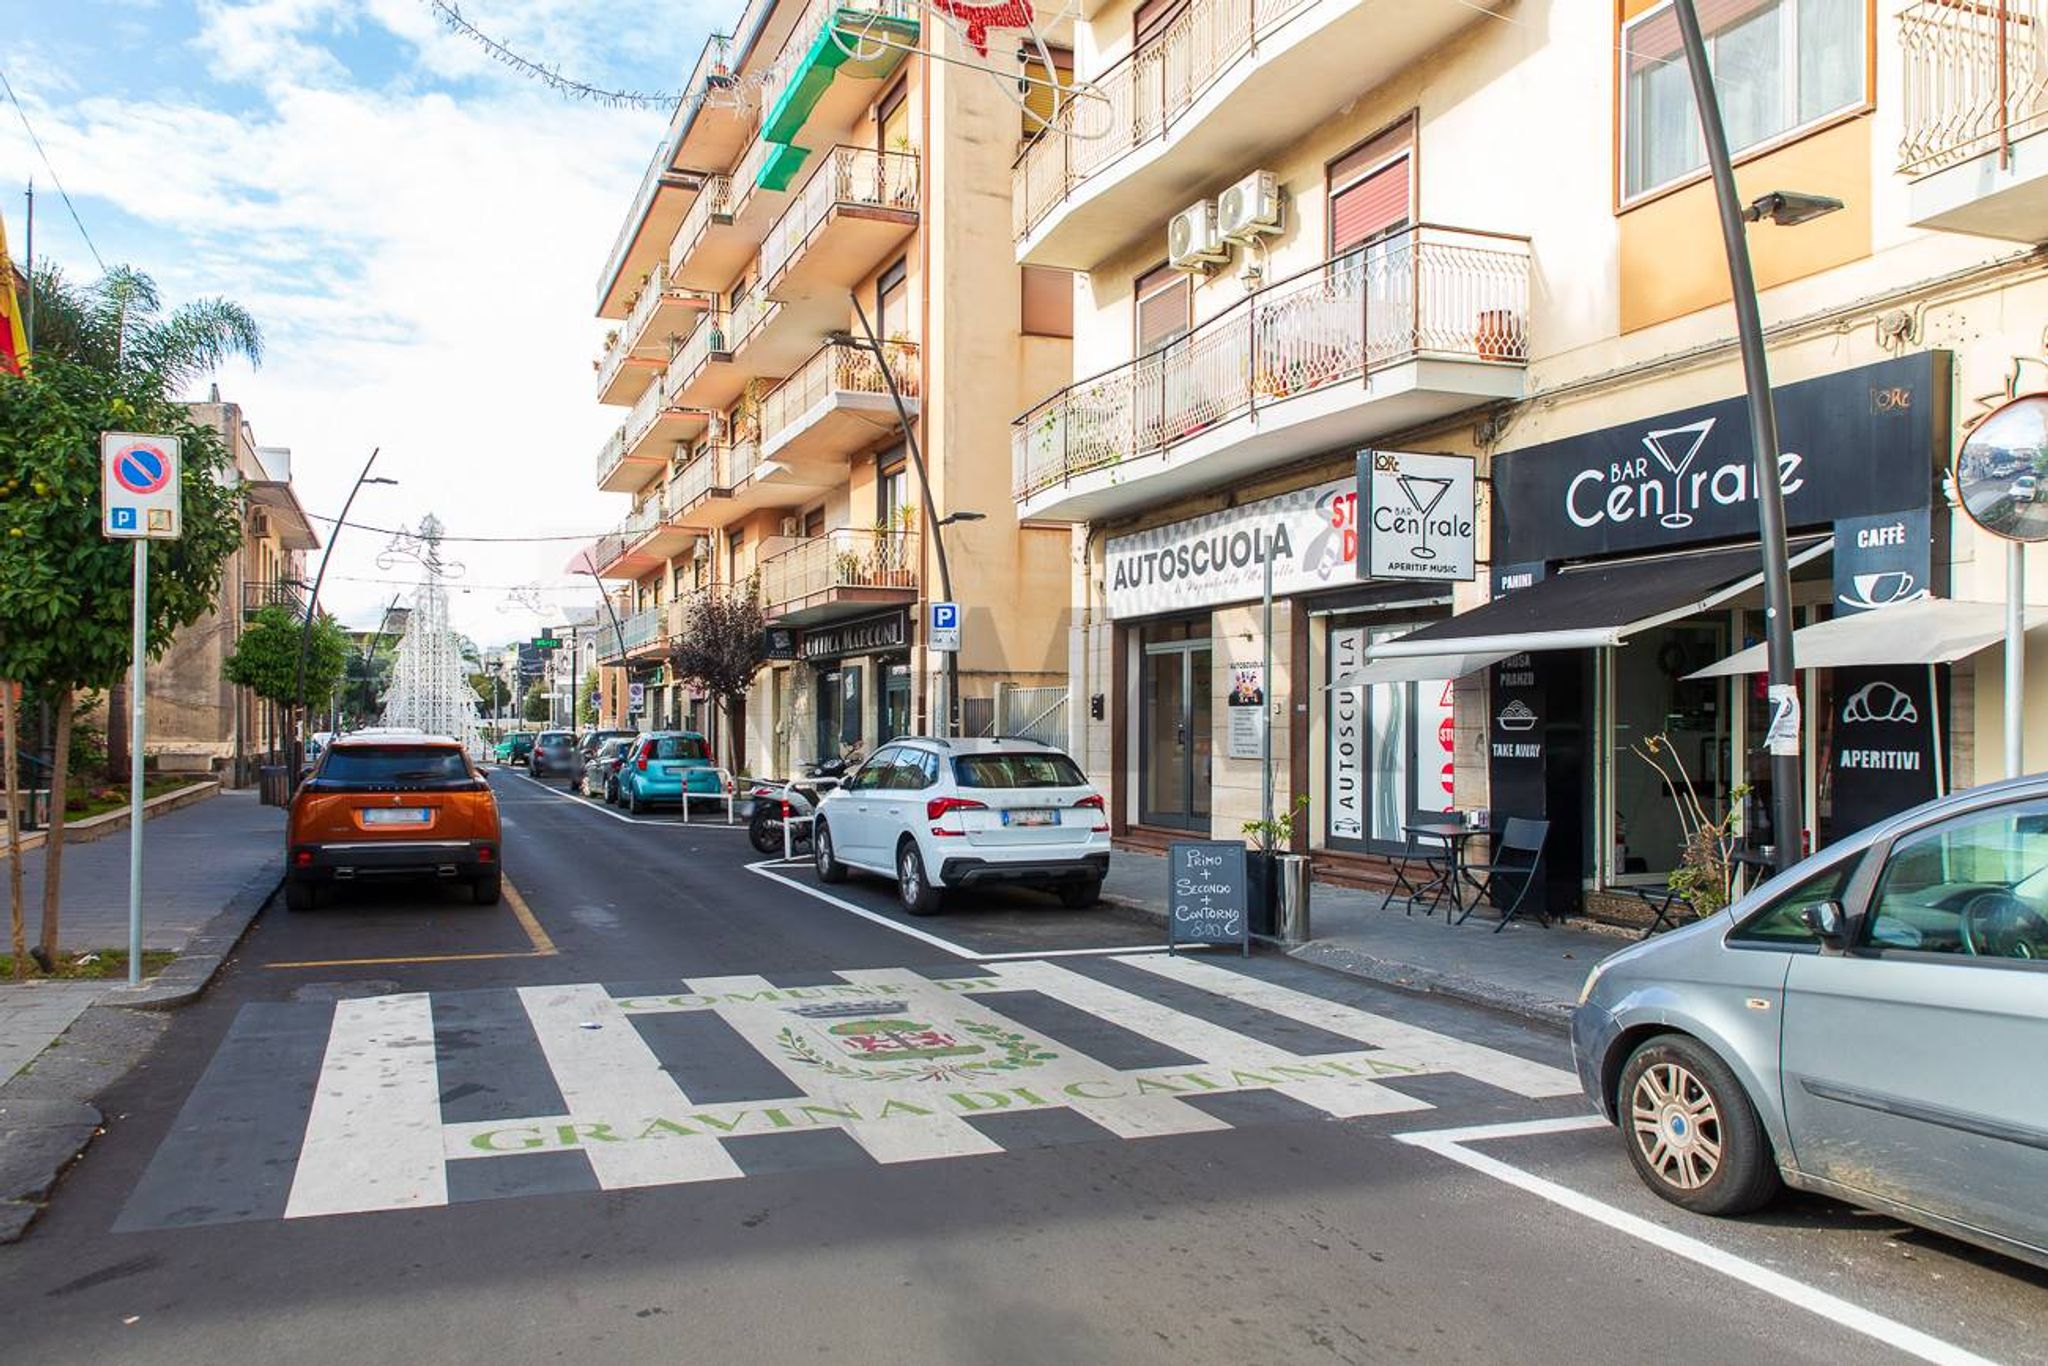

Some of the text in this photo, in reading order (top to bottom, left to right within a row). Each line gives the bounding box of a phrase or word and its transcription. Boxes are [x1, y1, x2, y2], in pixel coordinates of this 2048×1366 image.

[1611, 458, 1648, 483] BAR
[119, 511, 129, 526] P
[1395, 507, 1412, 516] BAR
[1857, 522, 1905, 548] CAFFÈ
[1114, 523, 1293, 591] AUTOSCUOLA
[1388, 562, 1457, 573] APERITIF MUSIC
[1502, 573, 1532, 590] PANINI
[937, 608, 953, 626] P
[842, 622, 899, 650] MARCONI
[1500, 671, 1535, 687] PRANZO
[1492, 743, 1541, 758] TAKE AWAY
[1841, 749, 1920, 771] APERITIVI
[618, 977, 1000, 1010] COMUNE DI
[470, 1058, 1420, 1152] GRAVINA DI CATANIA
